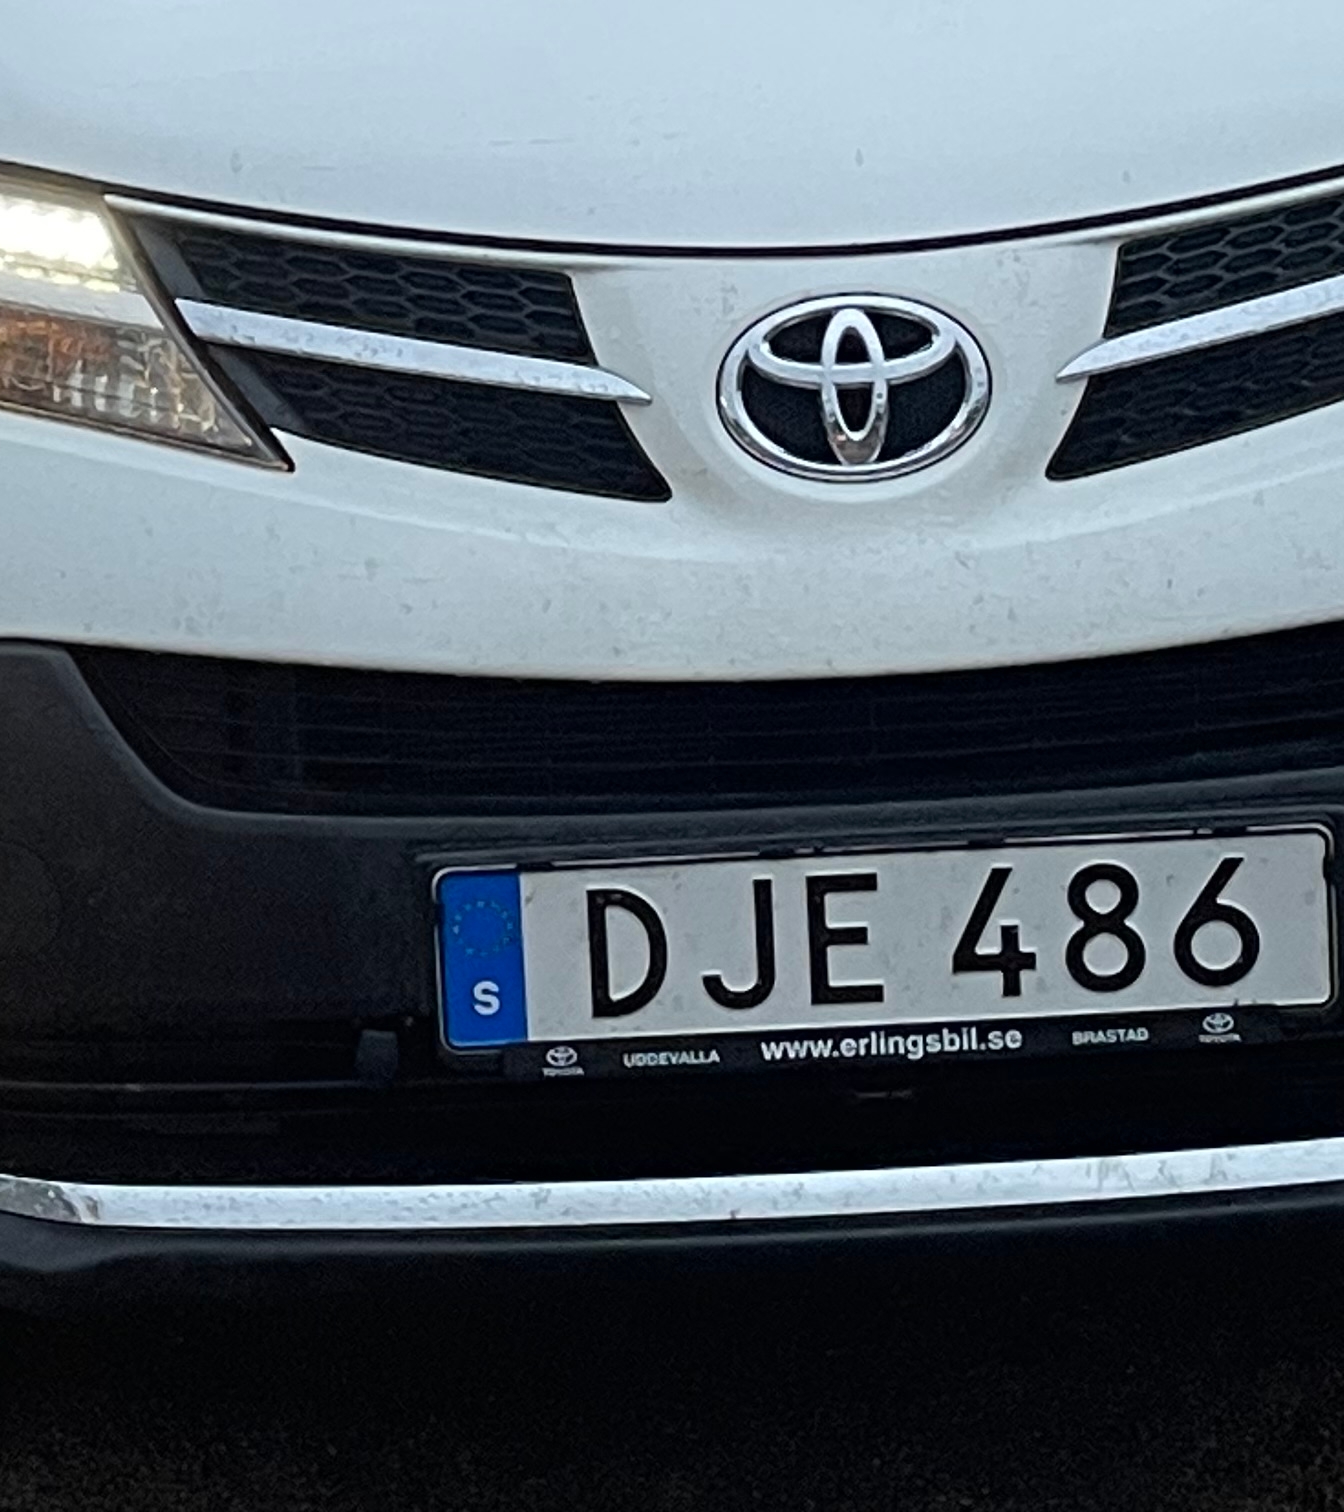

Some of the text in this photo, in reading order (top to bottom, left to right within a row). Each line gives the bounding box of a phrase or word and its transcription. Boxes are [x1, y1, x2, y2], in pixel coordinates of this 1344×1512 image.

[585, 857, 1261, 1019] DJE 486
[473, 980, 501, 1016] S
[622, 1026, 1150, 1068] UDDEVALLA www.erlingsbil.se BRASTAD
